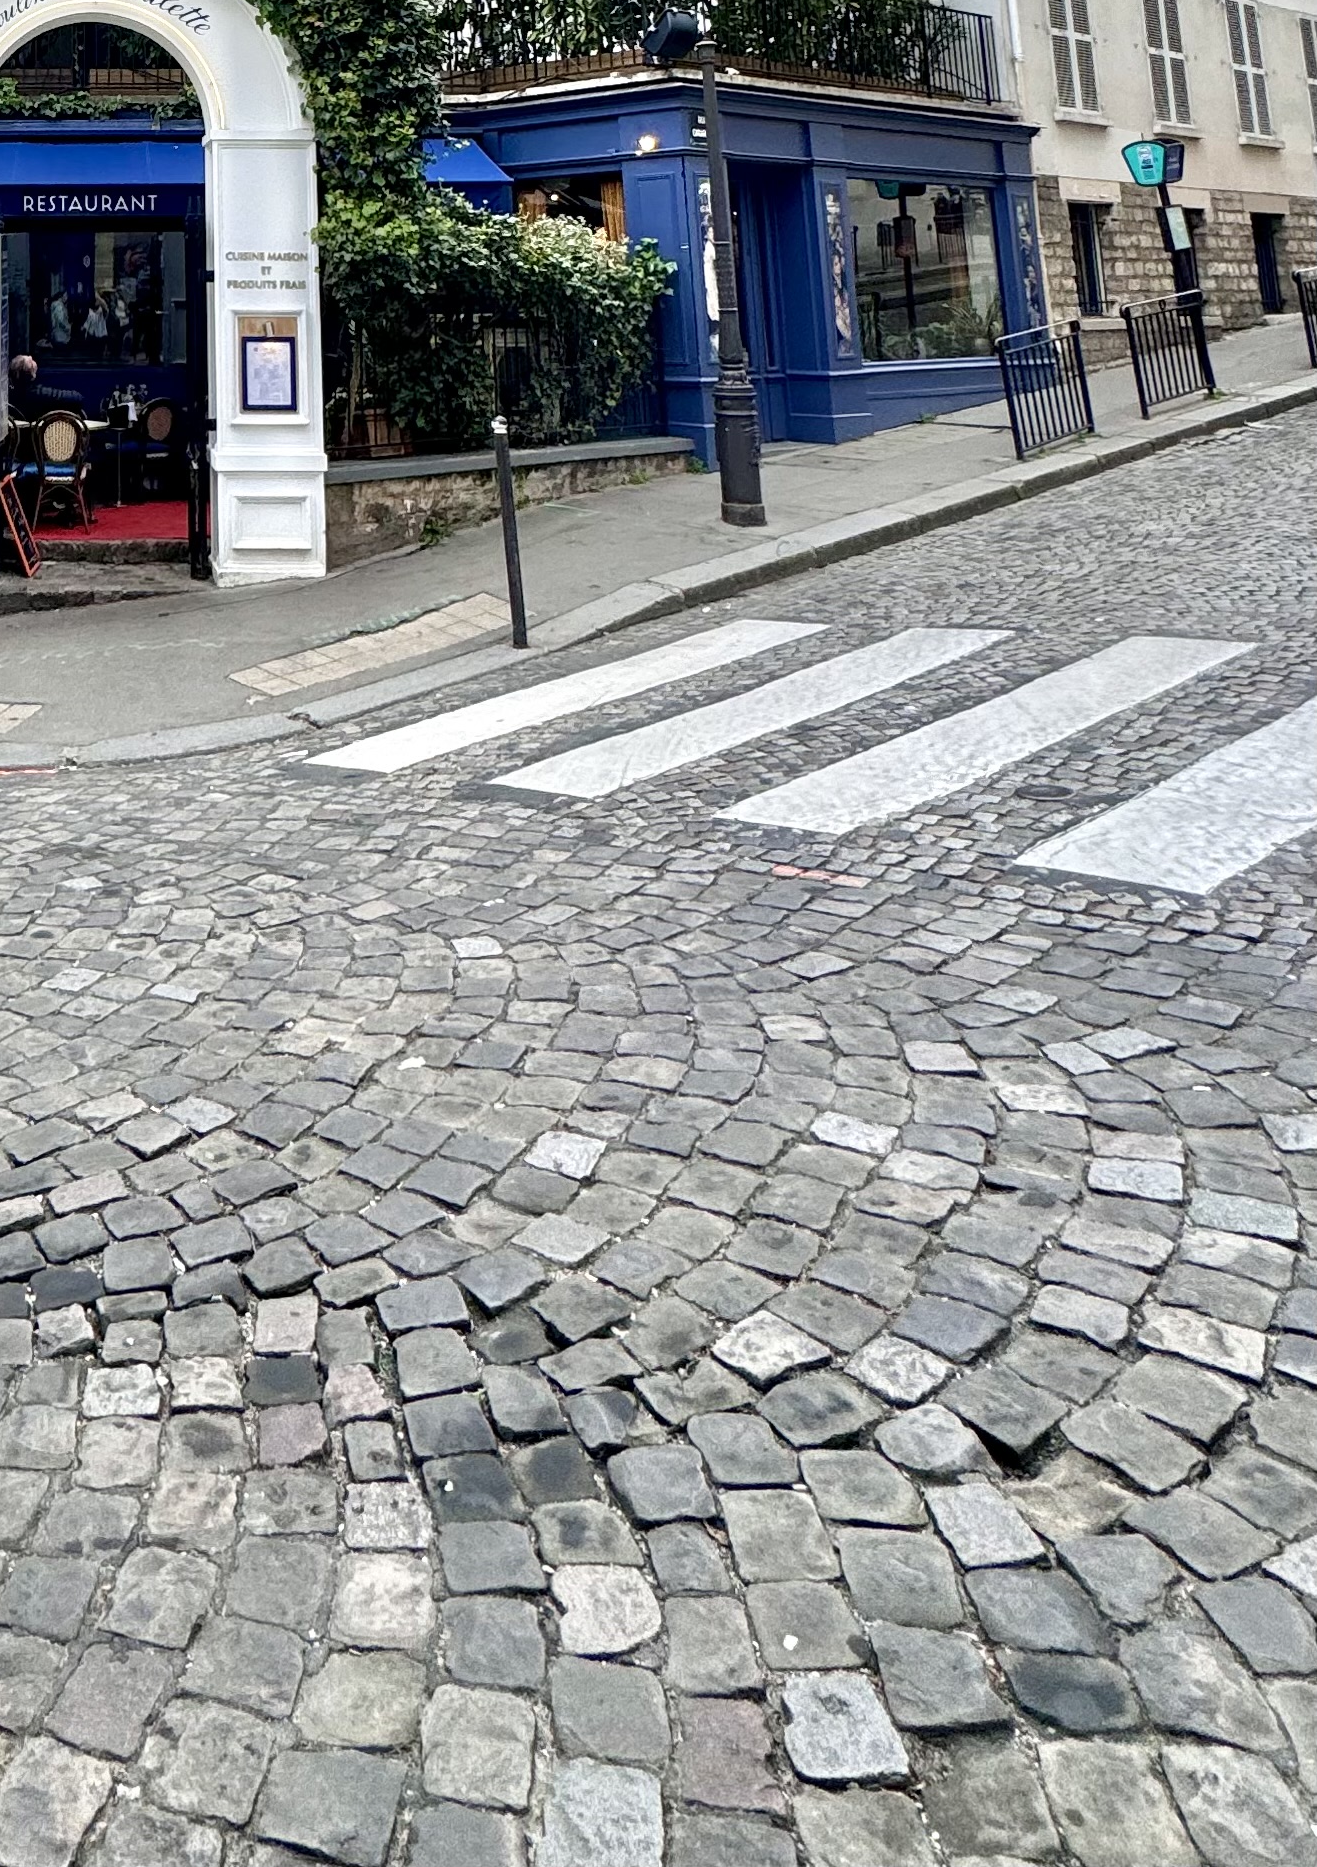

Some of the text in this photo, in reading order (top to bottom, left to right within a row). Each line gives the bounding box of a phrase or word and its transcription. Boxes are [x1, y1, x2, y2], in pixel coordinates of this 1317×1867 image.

[23, 194, 158, 212] RESTAURANT
[225, 251, 308, 262] CUISINE MAISON
[260, 265, 272, 276] ET
[226, 279, 307, 290] PRODUITS FRAIS
